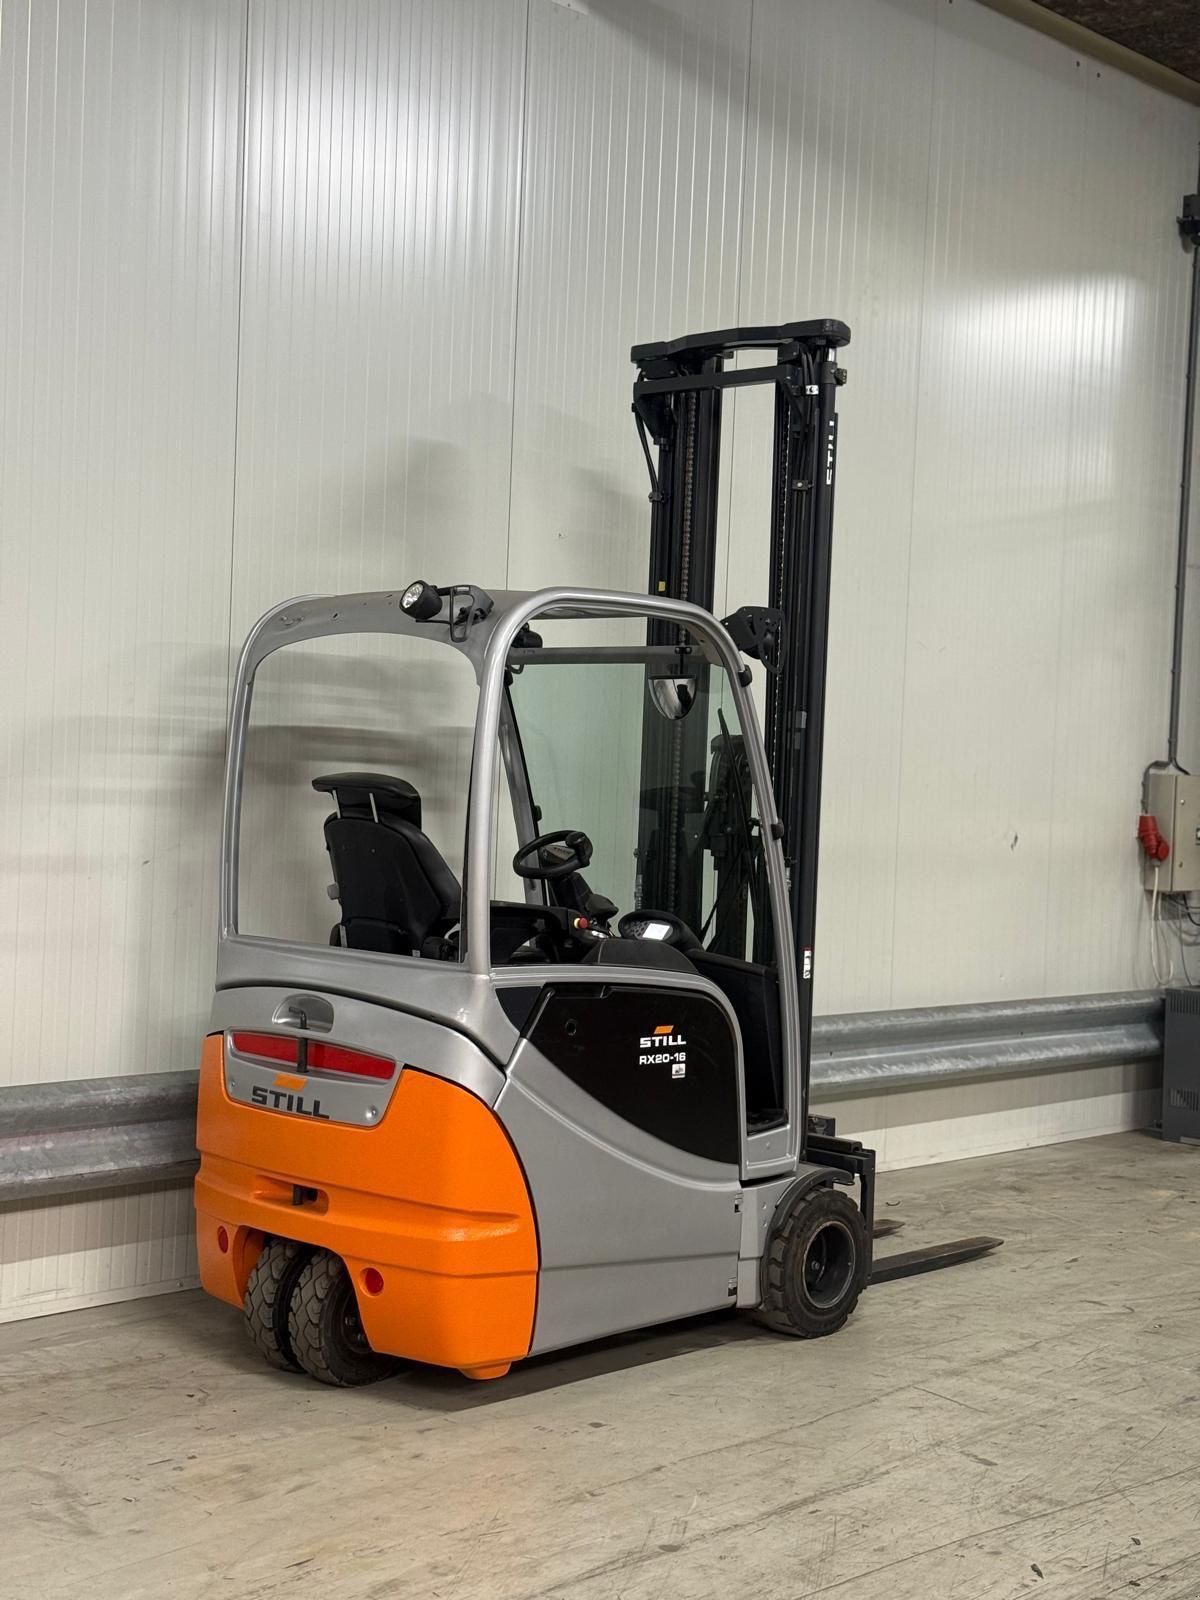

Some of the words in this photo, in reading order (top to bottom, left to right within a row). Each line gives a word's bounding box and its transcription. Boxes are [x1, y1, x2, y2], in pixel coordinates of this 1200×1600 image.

[639, 1034, 687, 1048] STILL
[639, 1052, 687, 1065] RX20-16
[251, 1085, 330, 1120] STILL
